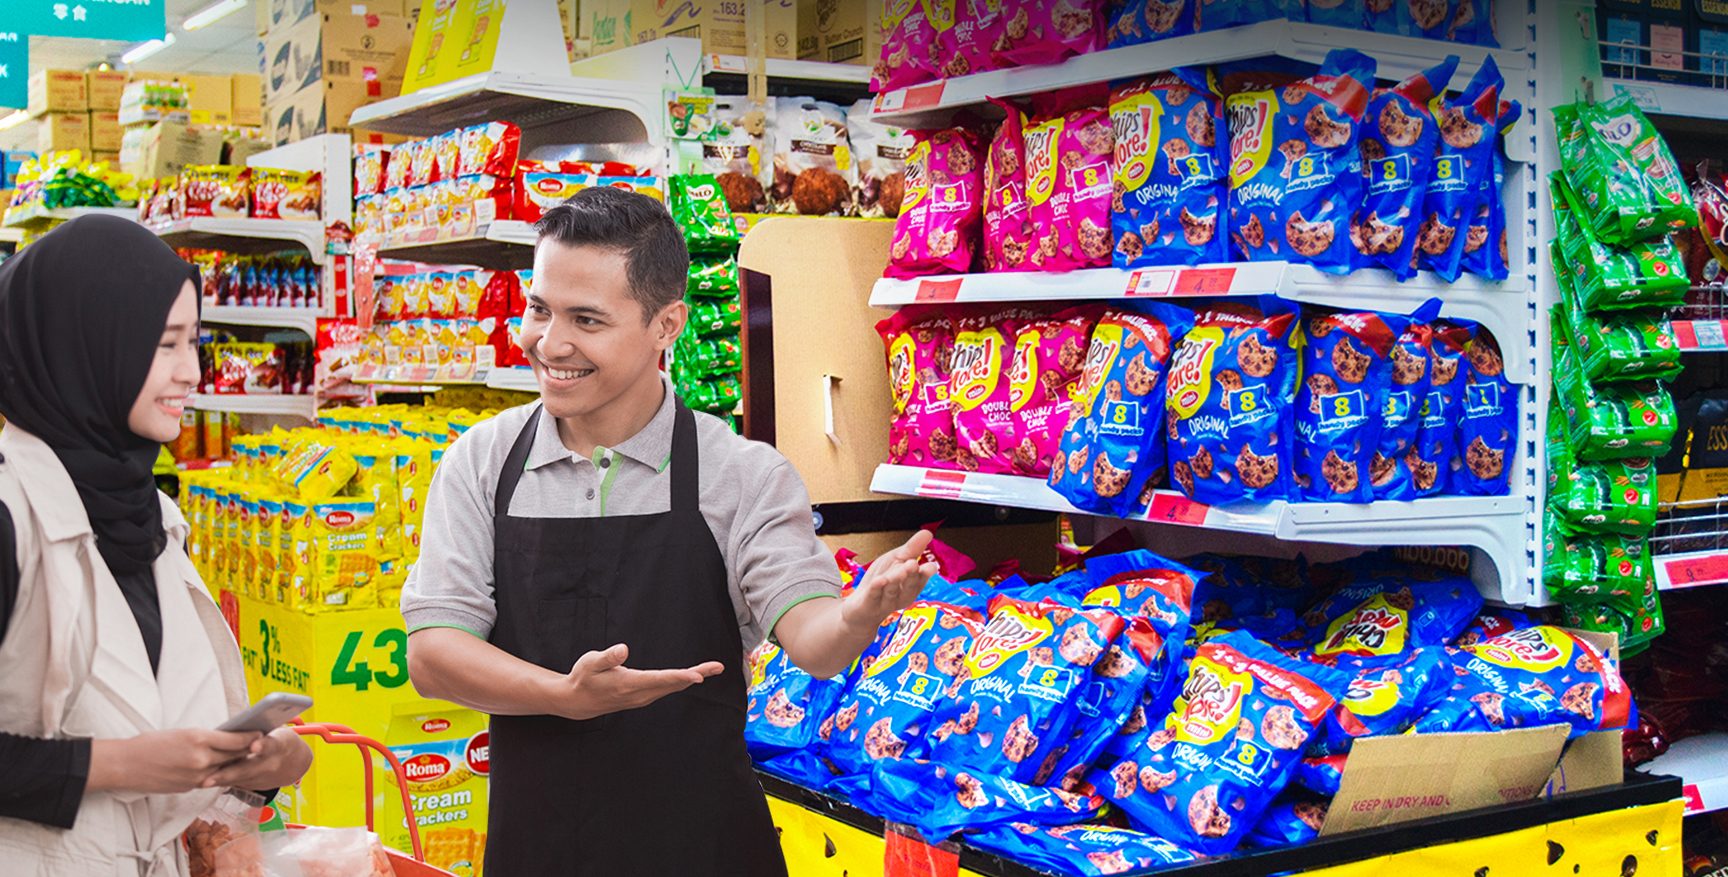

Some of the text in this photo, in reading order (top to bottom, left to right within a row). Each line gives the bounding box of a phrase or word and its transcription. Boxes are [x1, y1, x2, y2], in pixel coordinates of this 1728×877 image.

[1186, 157, 1201, 175] 8
[1298, 157, 1314, 177] 8
[1383, 160, 1398, 180] 8
[1437, 159, 1452, 179] 8
[1083, 168, 1099, 187] 8
[943, 187, 958, 203] 8
[1002, 188, 1013, 206] 8
[1237, 182, 1284, 206] ORIGINAL
[935, 384, 949, 400] 8
[1239, 391, 1257, 412] 8
[981, 401, 1009, 415] DOUBL
[1113, 404, 1127, 424] 8
[1333, 396, 1351, 417] 8
[1187, 414, 1230, 440] ORIGINAL
[327, 533, 368, 543] Cream
[327, 542, 366, 552] Crackers
[331, 628, 410, 692] 43
[271, 658, 310, 693] LESS FAT
[1039, 669, 1058, 688] 8
[911, 676, 930, 696] 8
[970, 676, 1016, 703] ORIGINAL
[424, 722, 448, 731] Roma
[469, 746, 489, 764] NE
[1237, 743, 1258, 765] 8
[405, 763, 446, 778] Roma
[1351, 798, 1380, 813] KEEP
[1381, 797, 1395, 811] IN
[1395, 795, 1420, 810] DRY
[1419, 794, 1446, 809] AND
